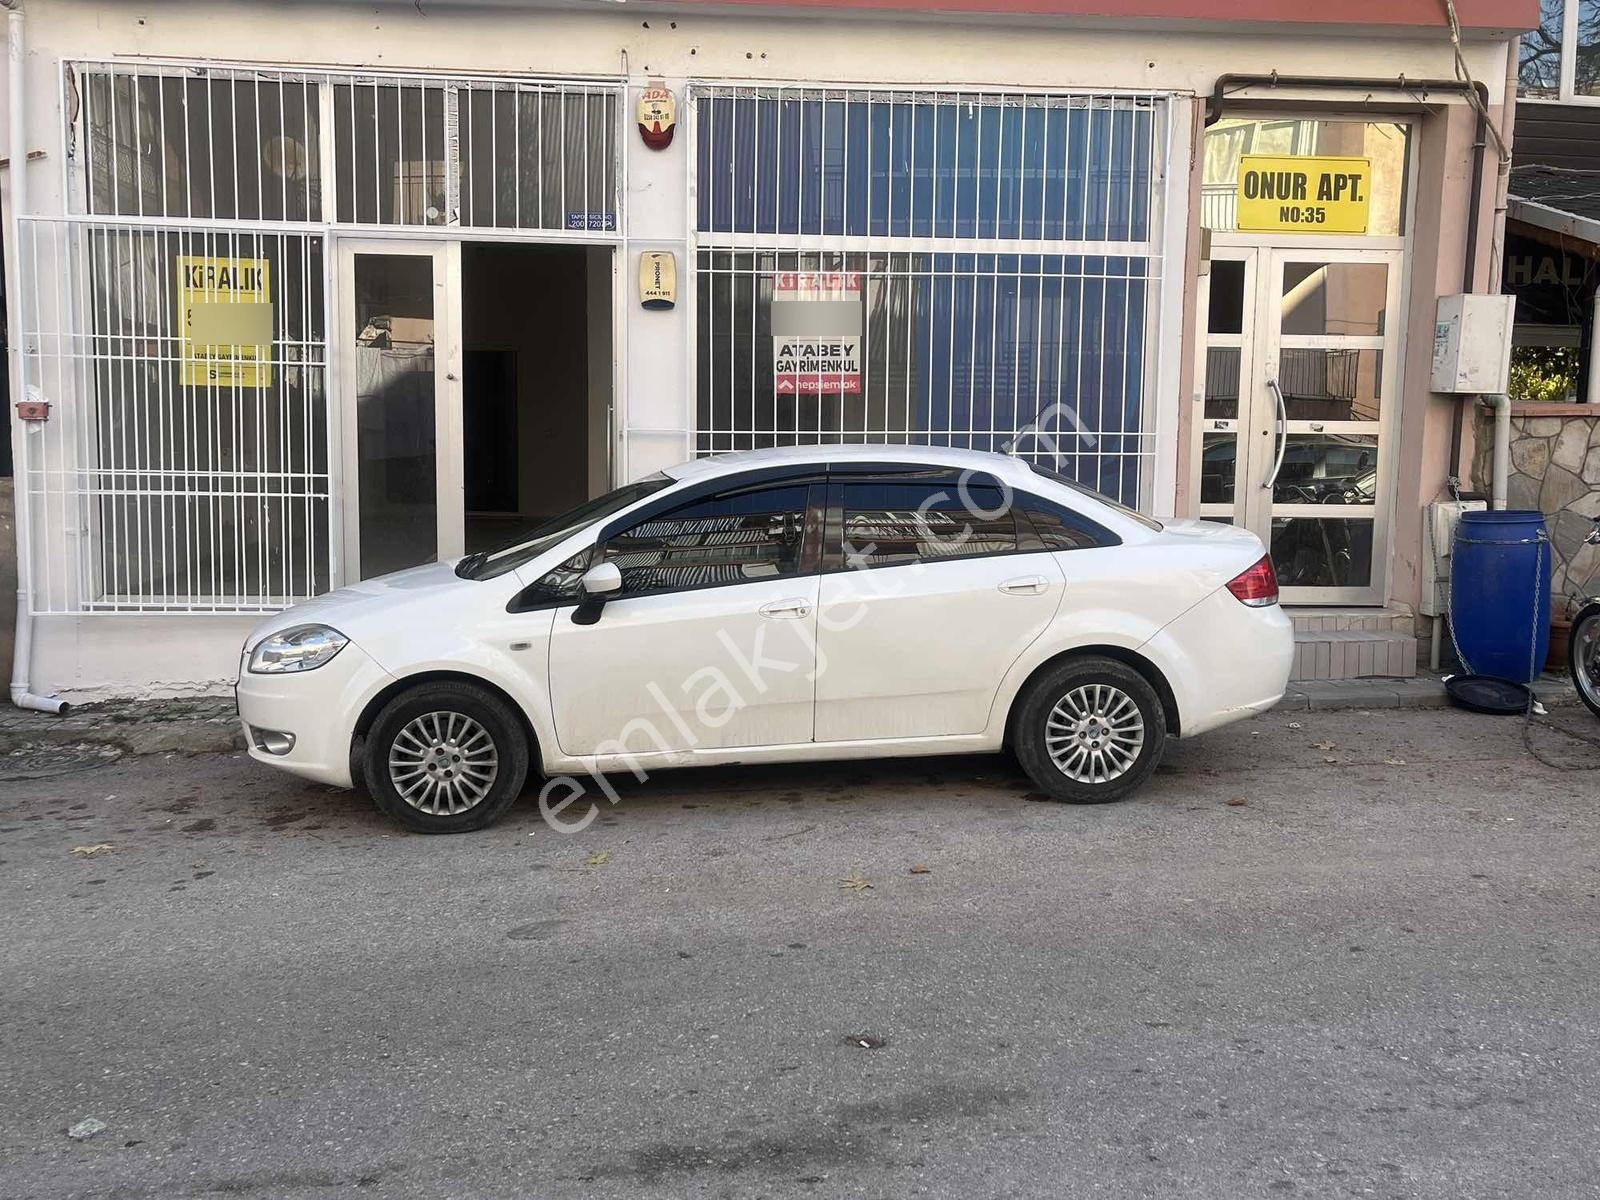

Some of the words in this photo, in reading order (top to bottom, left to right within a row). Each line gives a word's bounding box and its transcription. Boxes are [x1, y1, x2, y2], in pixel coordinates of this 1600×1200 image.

[642, 90, 669, 99] ADA
[1244, 171, 1307, 200] ONUR
[1317, 173, 1363, 202] APT.
[1280, 206, 1325, 223] NO:35
[780, 344, 854, 357] ATABEY
[776, 356, 858, 373] GAYRİMENKUL
